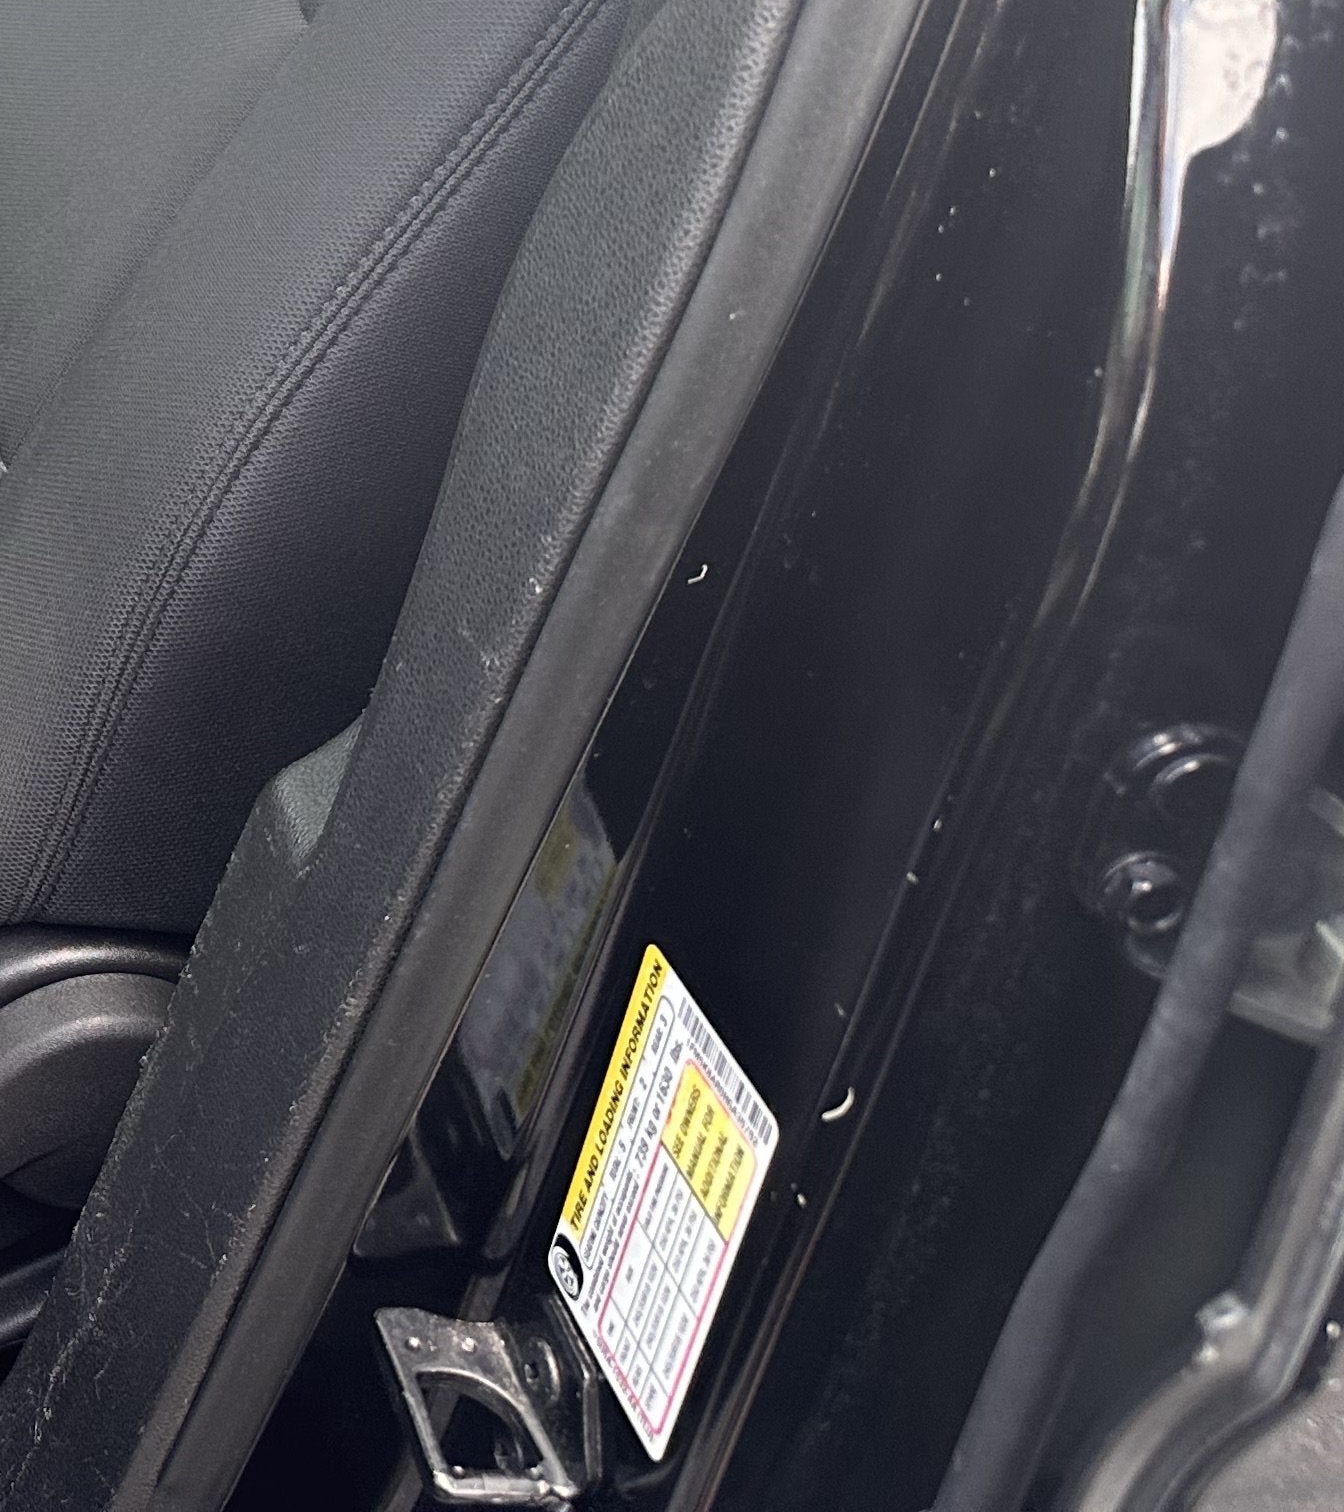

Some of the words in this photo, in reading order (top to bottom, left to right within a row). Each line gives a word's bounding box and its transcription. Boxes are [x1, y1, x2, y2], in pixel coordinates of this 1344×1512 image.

[570, 1190, 587, 1230] TIRE
[584, 1155, 598, 1192] AND
[595, 1080, 623, 1155] LOADING
[620, 960, 662, 1079] INFORMATION
[644, 1119, 657, 1139] kg
[652, 1103, 660, 1120] or
[673, 1135, 684, 1158] SEE
[680, 1085, 700, 1136] OWNERS
[686, 1134, 706, 1179] MANUAL
[702, 1105, 714, 1131] FOR
[700, 1134, 727, 1199] ADDITIONAL
[711, 1146, 744, 1227] INFORMATION
